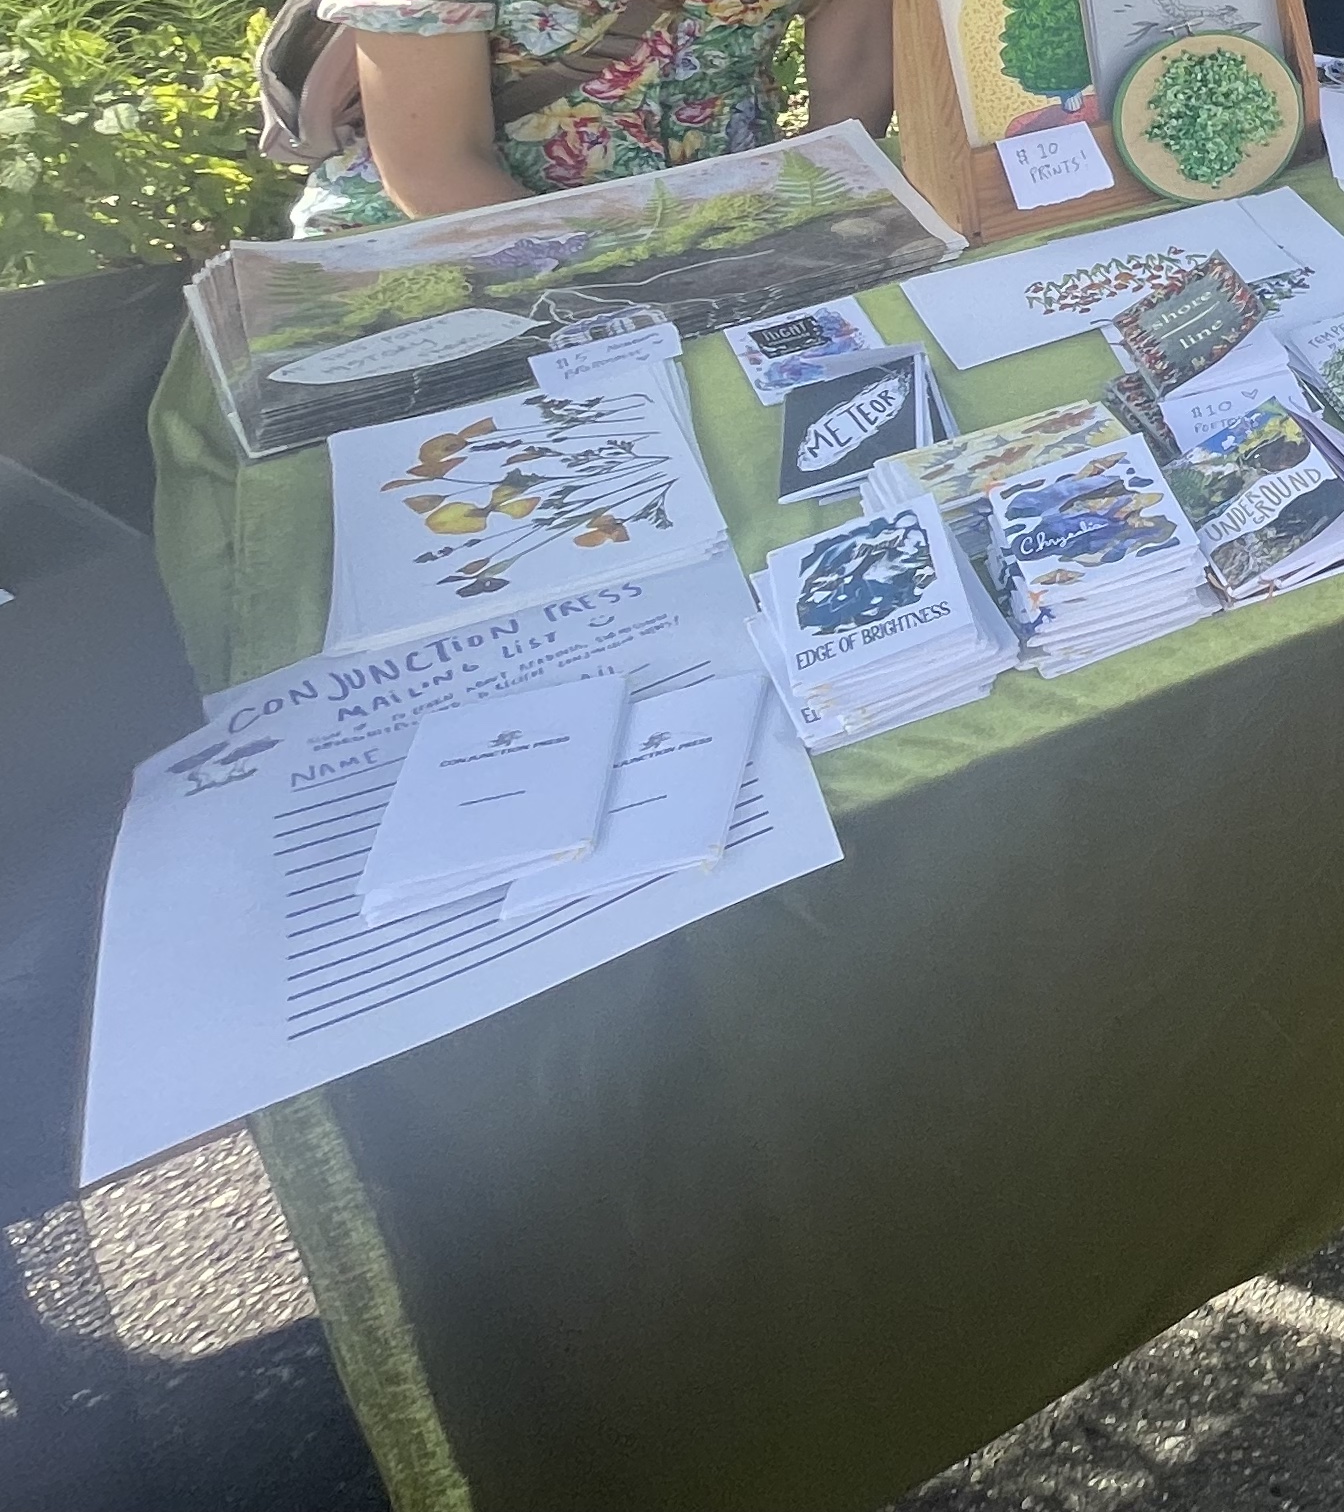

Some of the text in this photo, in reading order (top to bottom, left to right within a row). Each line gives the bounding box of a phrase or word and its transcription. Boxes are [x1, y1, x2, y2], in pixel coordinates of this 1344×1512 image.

[1179, 318, 1224, 350] line
[543, 582, 643, 622] PRESS
[796, 601, 952, 671] EDGE OF BRIGHTNESS
[291, 747, 380, 788] NAME
